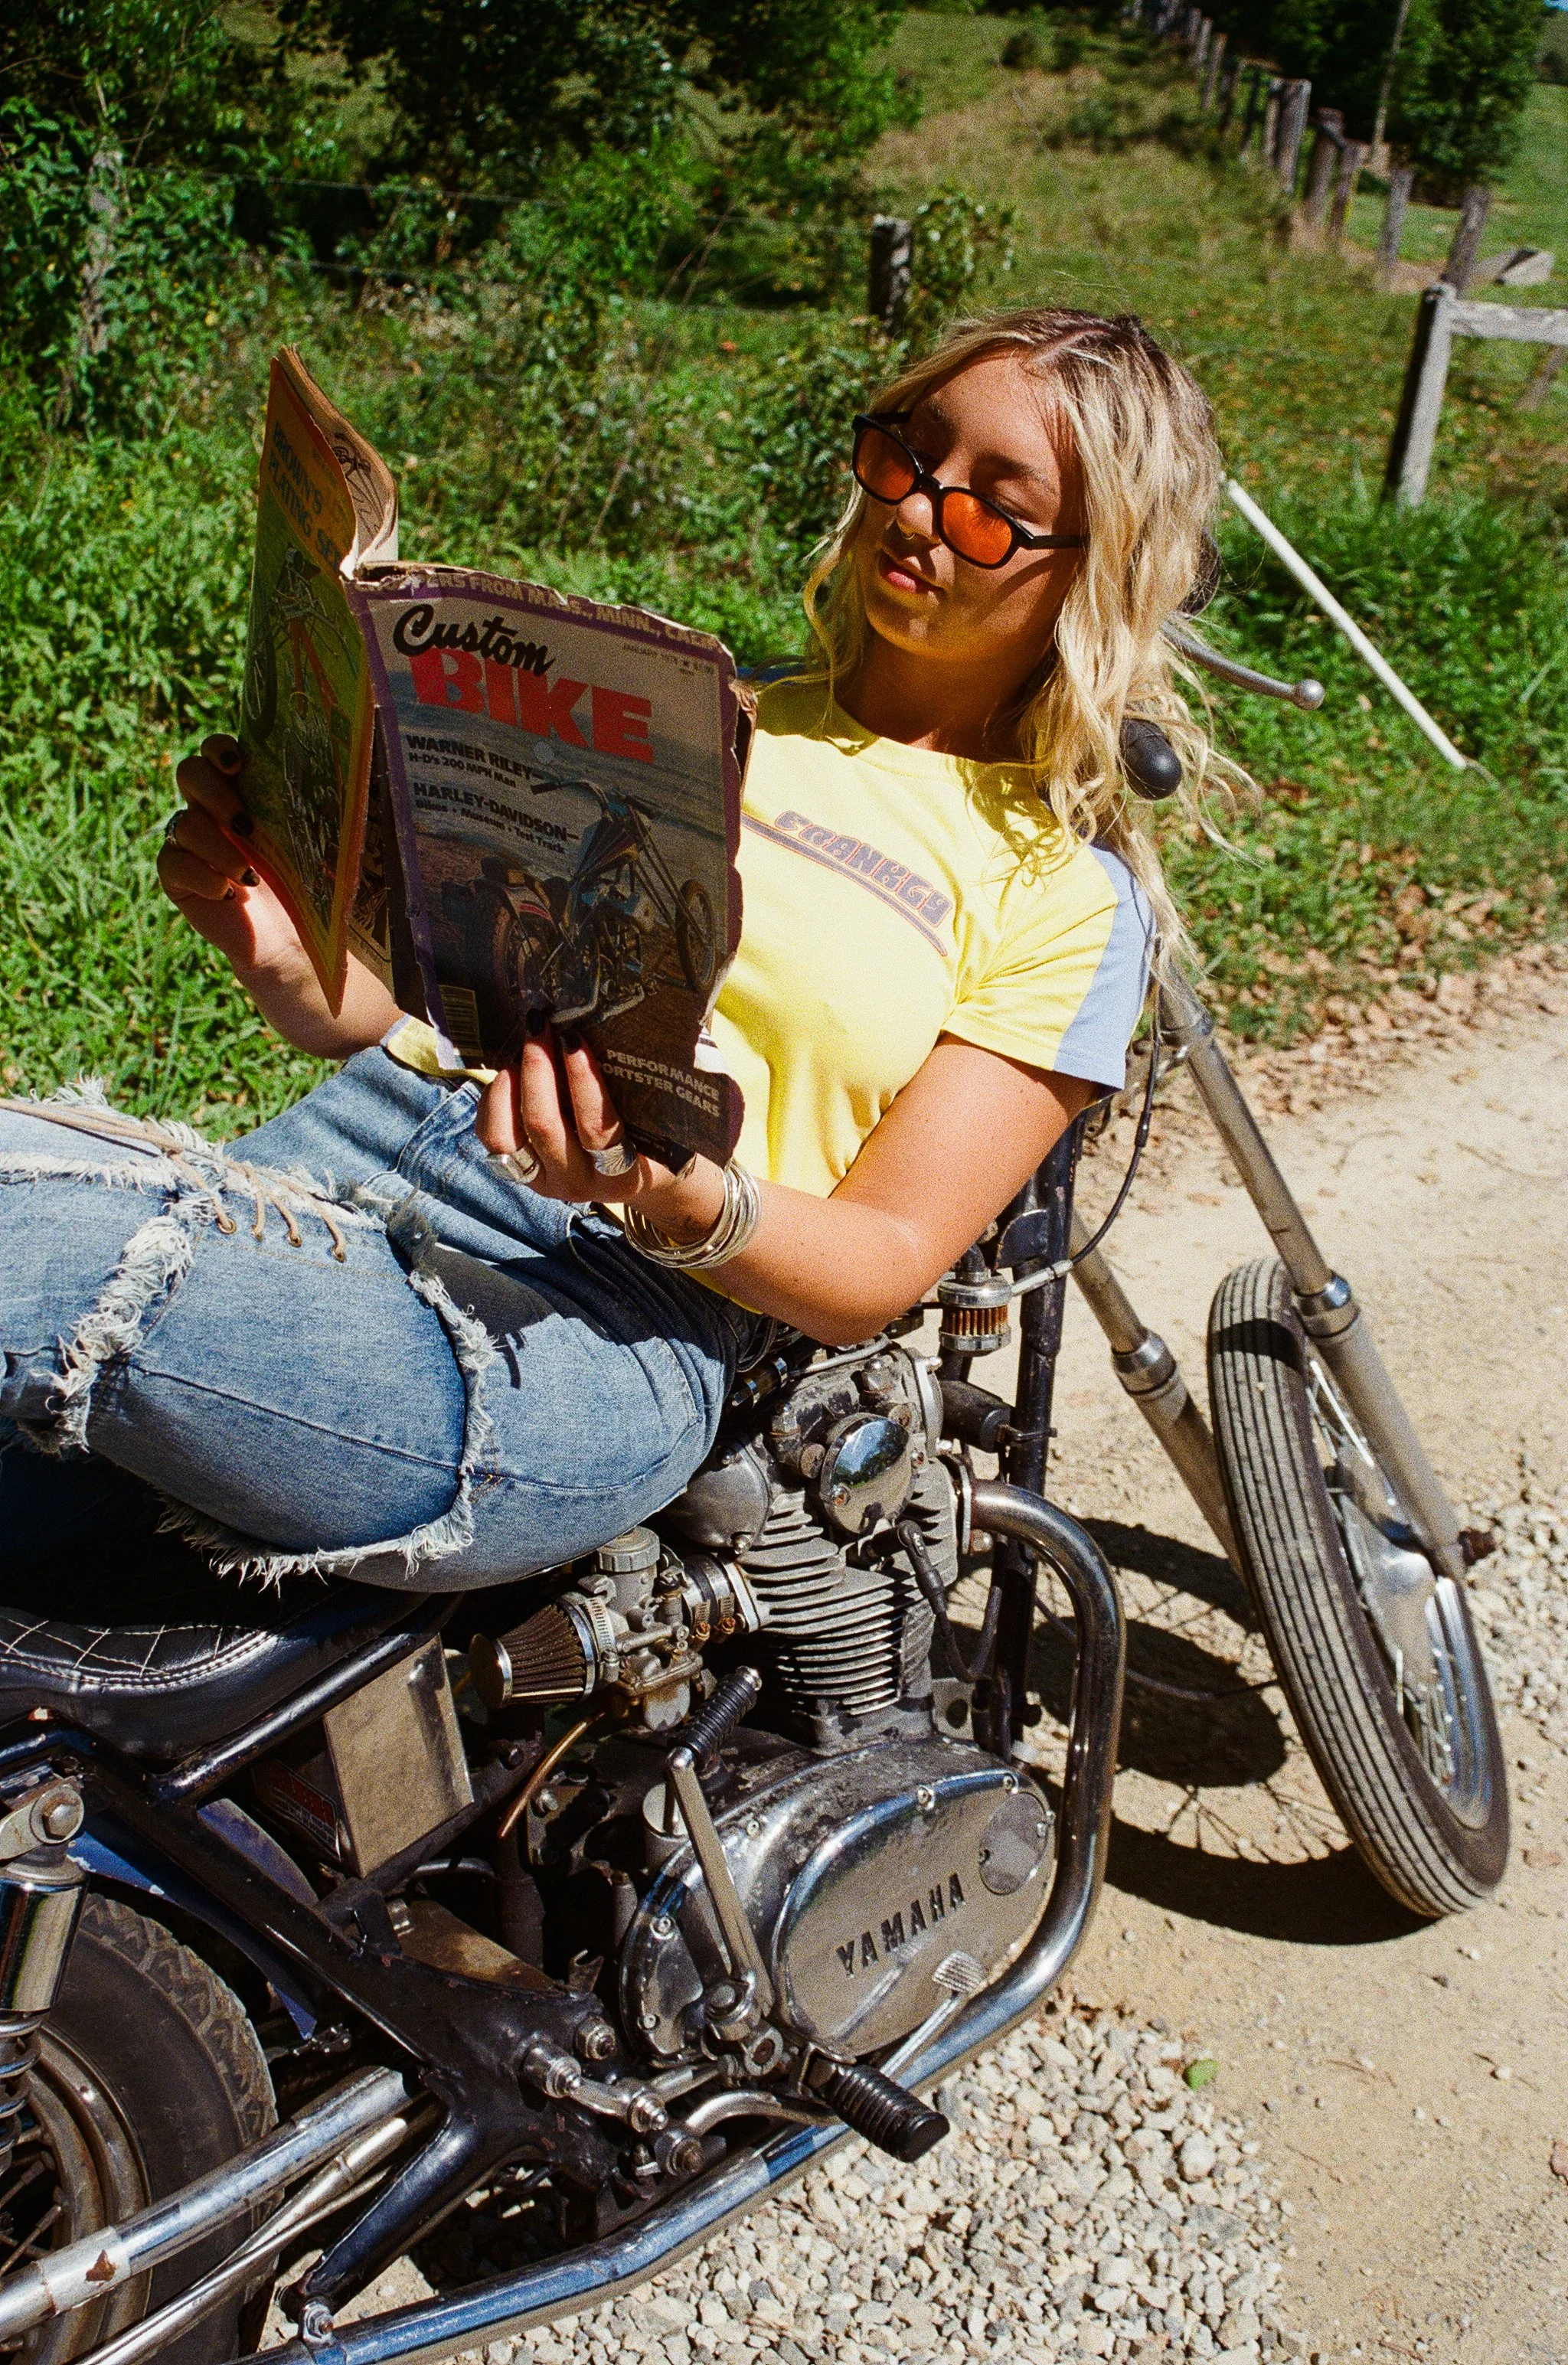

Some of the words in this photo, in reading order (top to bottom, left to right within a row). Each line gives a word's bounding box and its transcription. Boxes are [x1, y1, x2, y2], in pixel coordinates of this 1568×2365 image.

[269, 450, 312, 537] PLATING
[471, 579, 524, 600] FROM
[392, 603, 556, 677] Custom
[409, 648, 655, 764] BIKE
[406, 733, 488, 765] WARNER
[408, 753, 440, 766] H-D's
[442, 756, 465, 771] 200
[466, 763, 493, 779] MPH
[494, 773, 518, 789] Man
[415, 799, 449, 813] Bikes
[461, 808, 506, 831] Museum
[514, 828, 538, 843] Test
[538, 837, 567, 854] Track
[606, 1049, 720, 1100] PERFORMANCE
[675, 1086, 720, 1118] GEARS
[835, 1872, 967, 1978] YAMAHA
